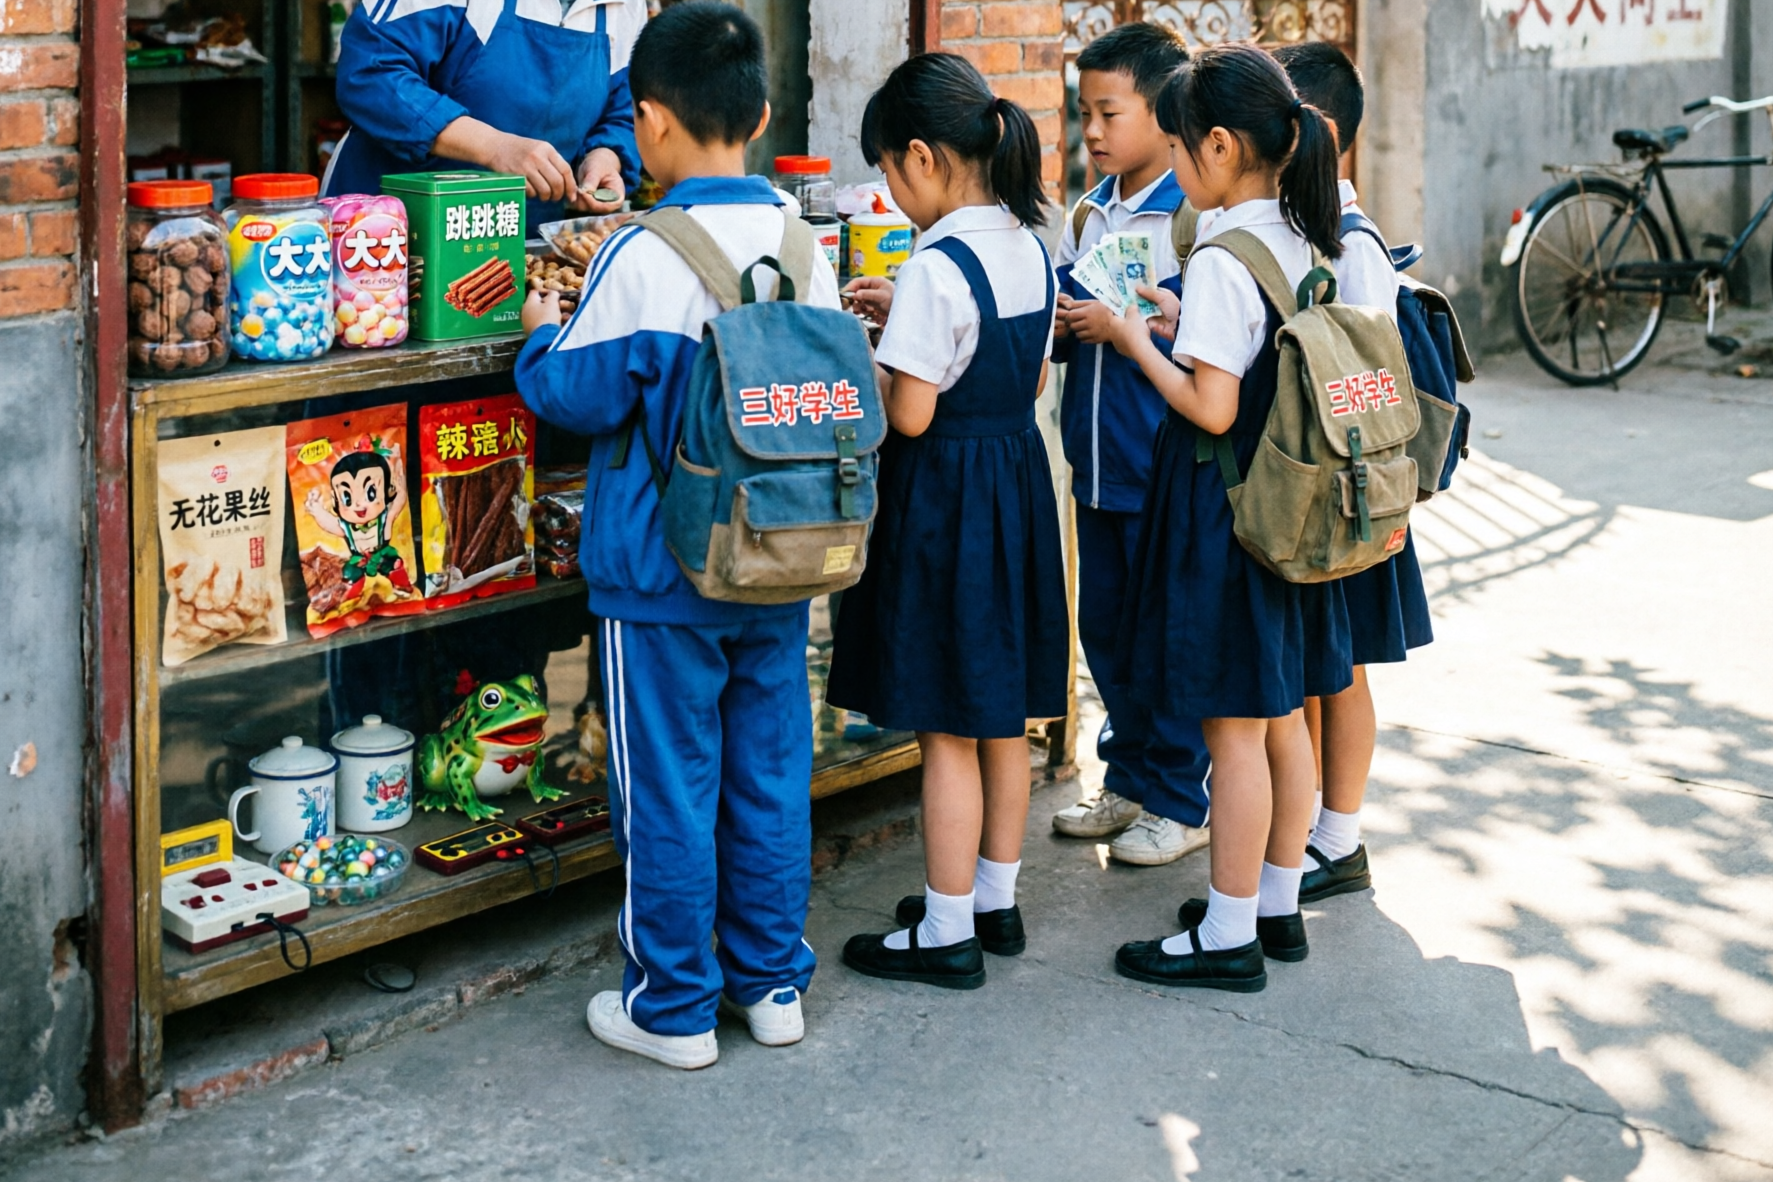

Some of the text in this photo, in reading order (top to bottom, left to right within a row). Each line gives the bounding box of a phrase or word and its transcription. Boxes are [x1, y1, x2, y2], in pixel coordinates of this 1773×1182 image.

[445, 201, 520, 241] 跳跳糖
[268, 235, 331, 278] 大大
[344, 228, 407, 269] 大大
[740, 380, 863, 427] 三好学生
[1325, 368, 1401, 416] 三好学生
[169, 486, 271, 531] 无花果丝
